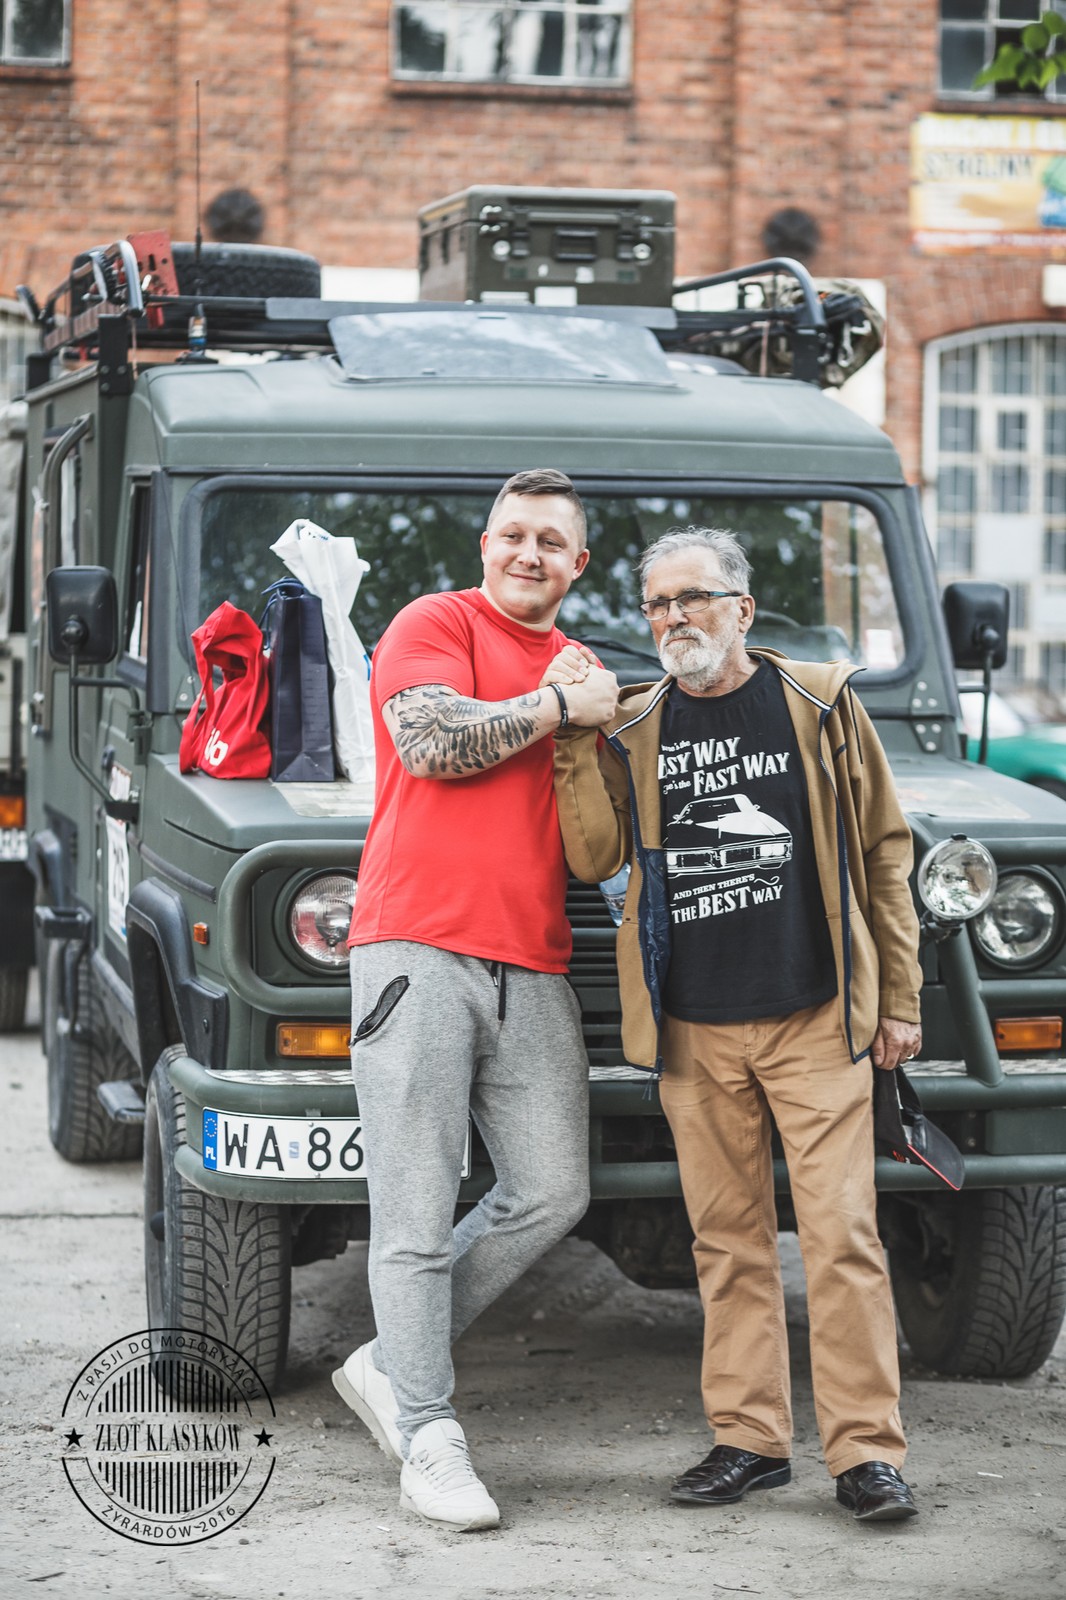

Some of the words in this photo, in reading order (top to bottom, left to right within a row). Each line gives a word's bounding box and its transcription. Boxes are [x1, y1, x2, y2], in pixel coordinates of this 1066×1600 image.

[692, 737, 741, 768] WAY
[692, 764, 741, 796] FAST
[741, 752, 790, 780] WAY
[672, 905, 698, 924] THE
[698, 885, 751, 919] BEST
[752, 884, 783, 905] WAY
[673, 889, 692, 901] AND
[692, 883, 716, 896] THEN
[717, 873, 755, 889] THERE'S
[205, 1145, 216, 1160] PL
[224, 1121, 285, 1172] WA
